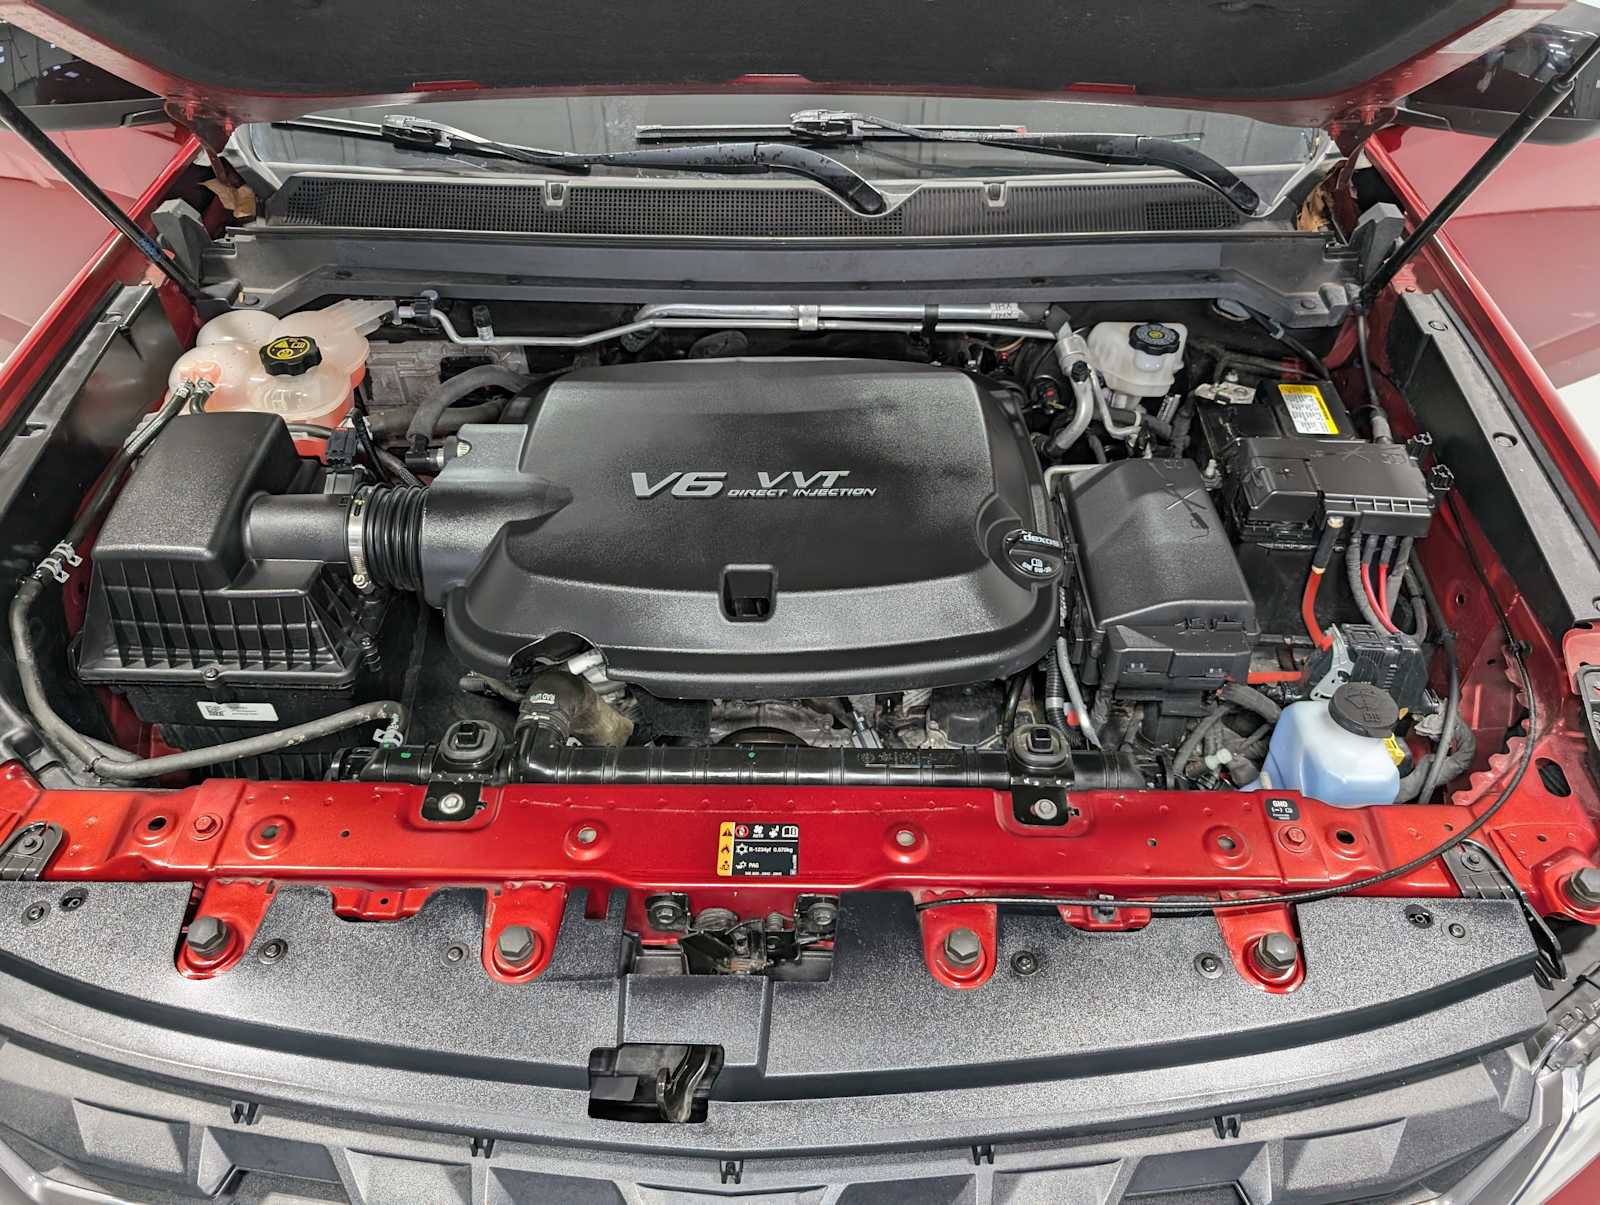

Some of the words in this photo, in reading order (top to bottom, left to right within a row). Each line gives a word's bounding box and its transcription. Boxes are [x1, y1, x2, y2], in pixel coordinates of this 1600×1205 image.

[631, 471, 728, 497] V6
[757, 470, 850, 488] VVT
[727, 489, 788, 497] DIRECT
[792, 487, 878, 497] INJECTION
[1023, 532, 1060, 547] dexos
